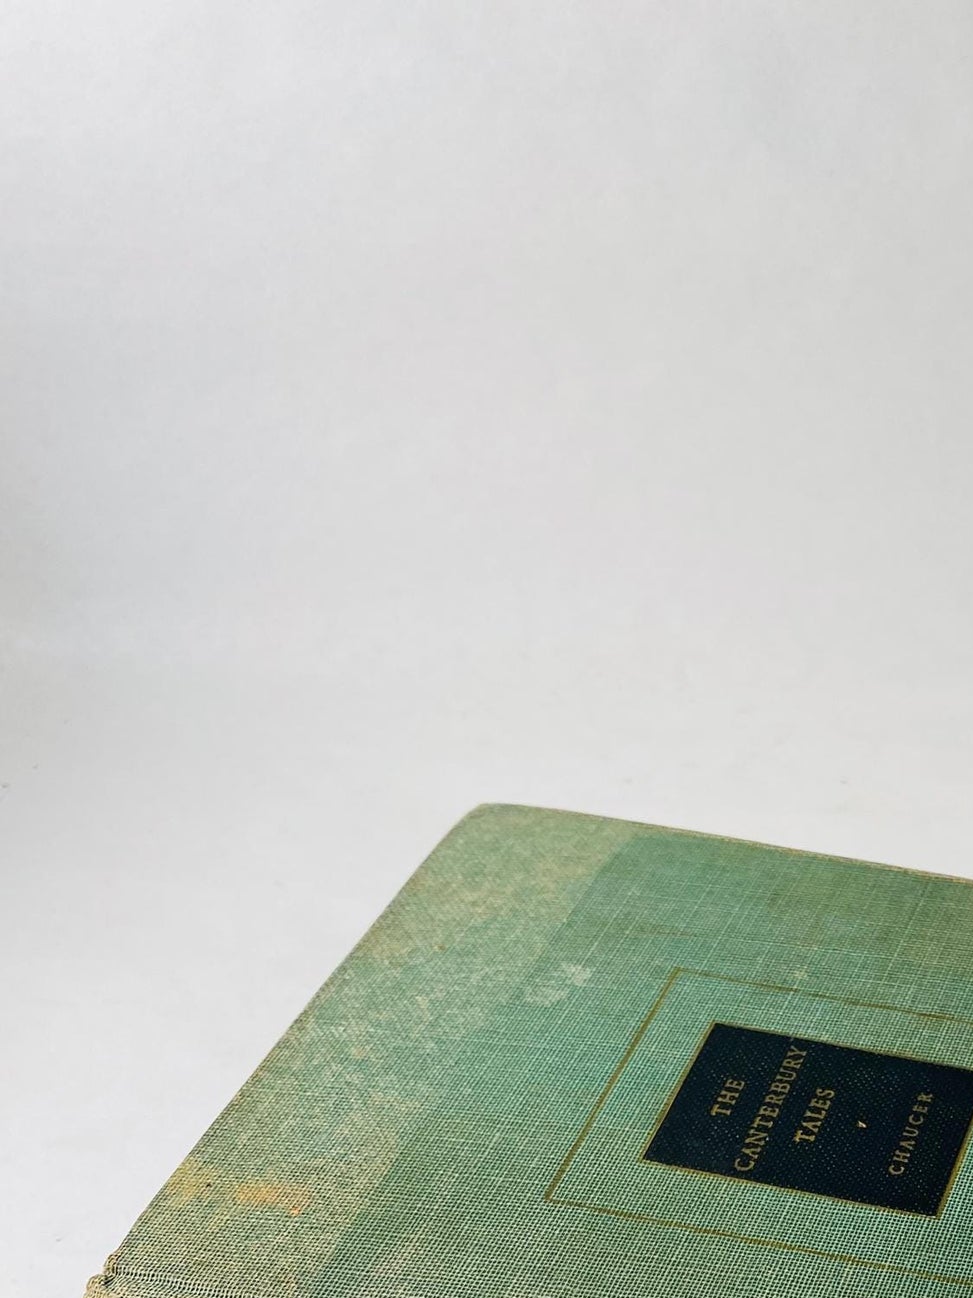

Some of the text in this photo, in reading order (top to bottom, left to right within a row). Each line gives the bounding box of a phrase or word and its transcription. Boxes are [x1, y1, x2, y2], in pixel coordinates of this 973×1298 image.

[709, 1077, 746, 1118] THE
[733, 1045, 808, 1172] CANTERBURY
[793, 1087, 837, 1144] TALES
[887, 1091, 934, 1177] CHAUCER
